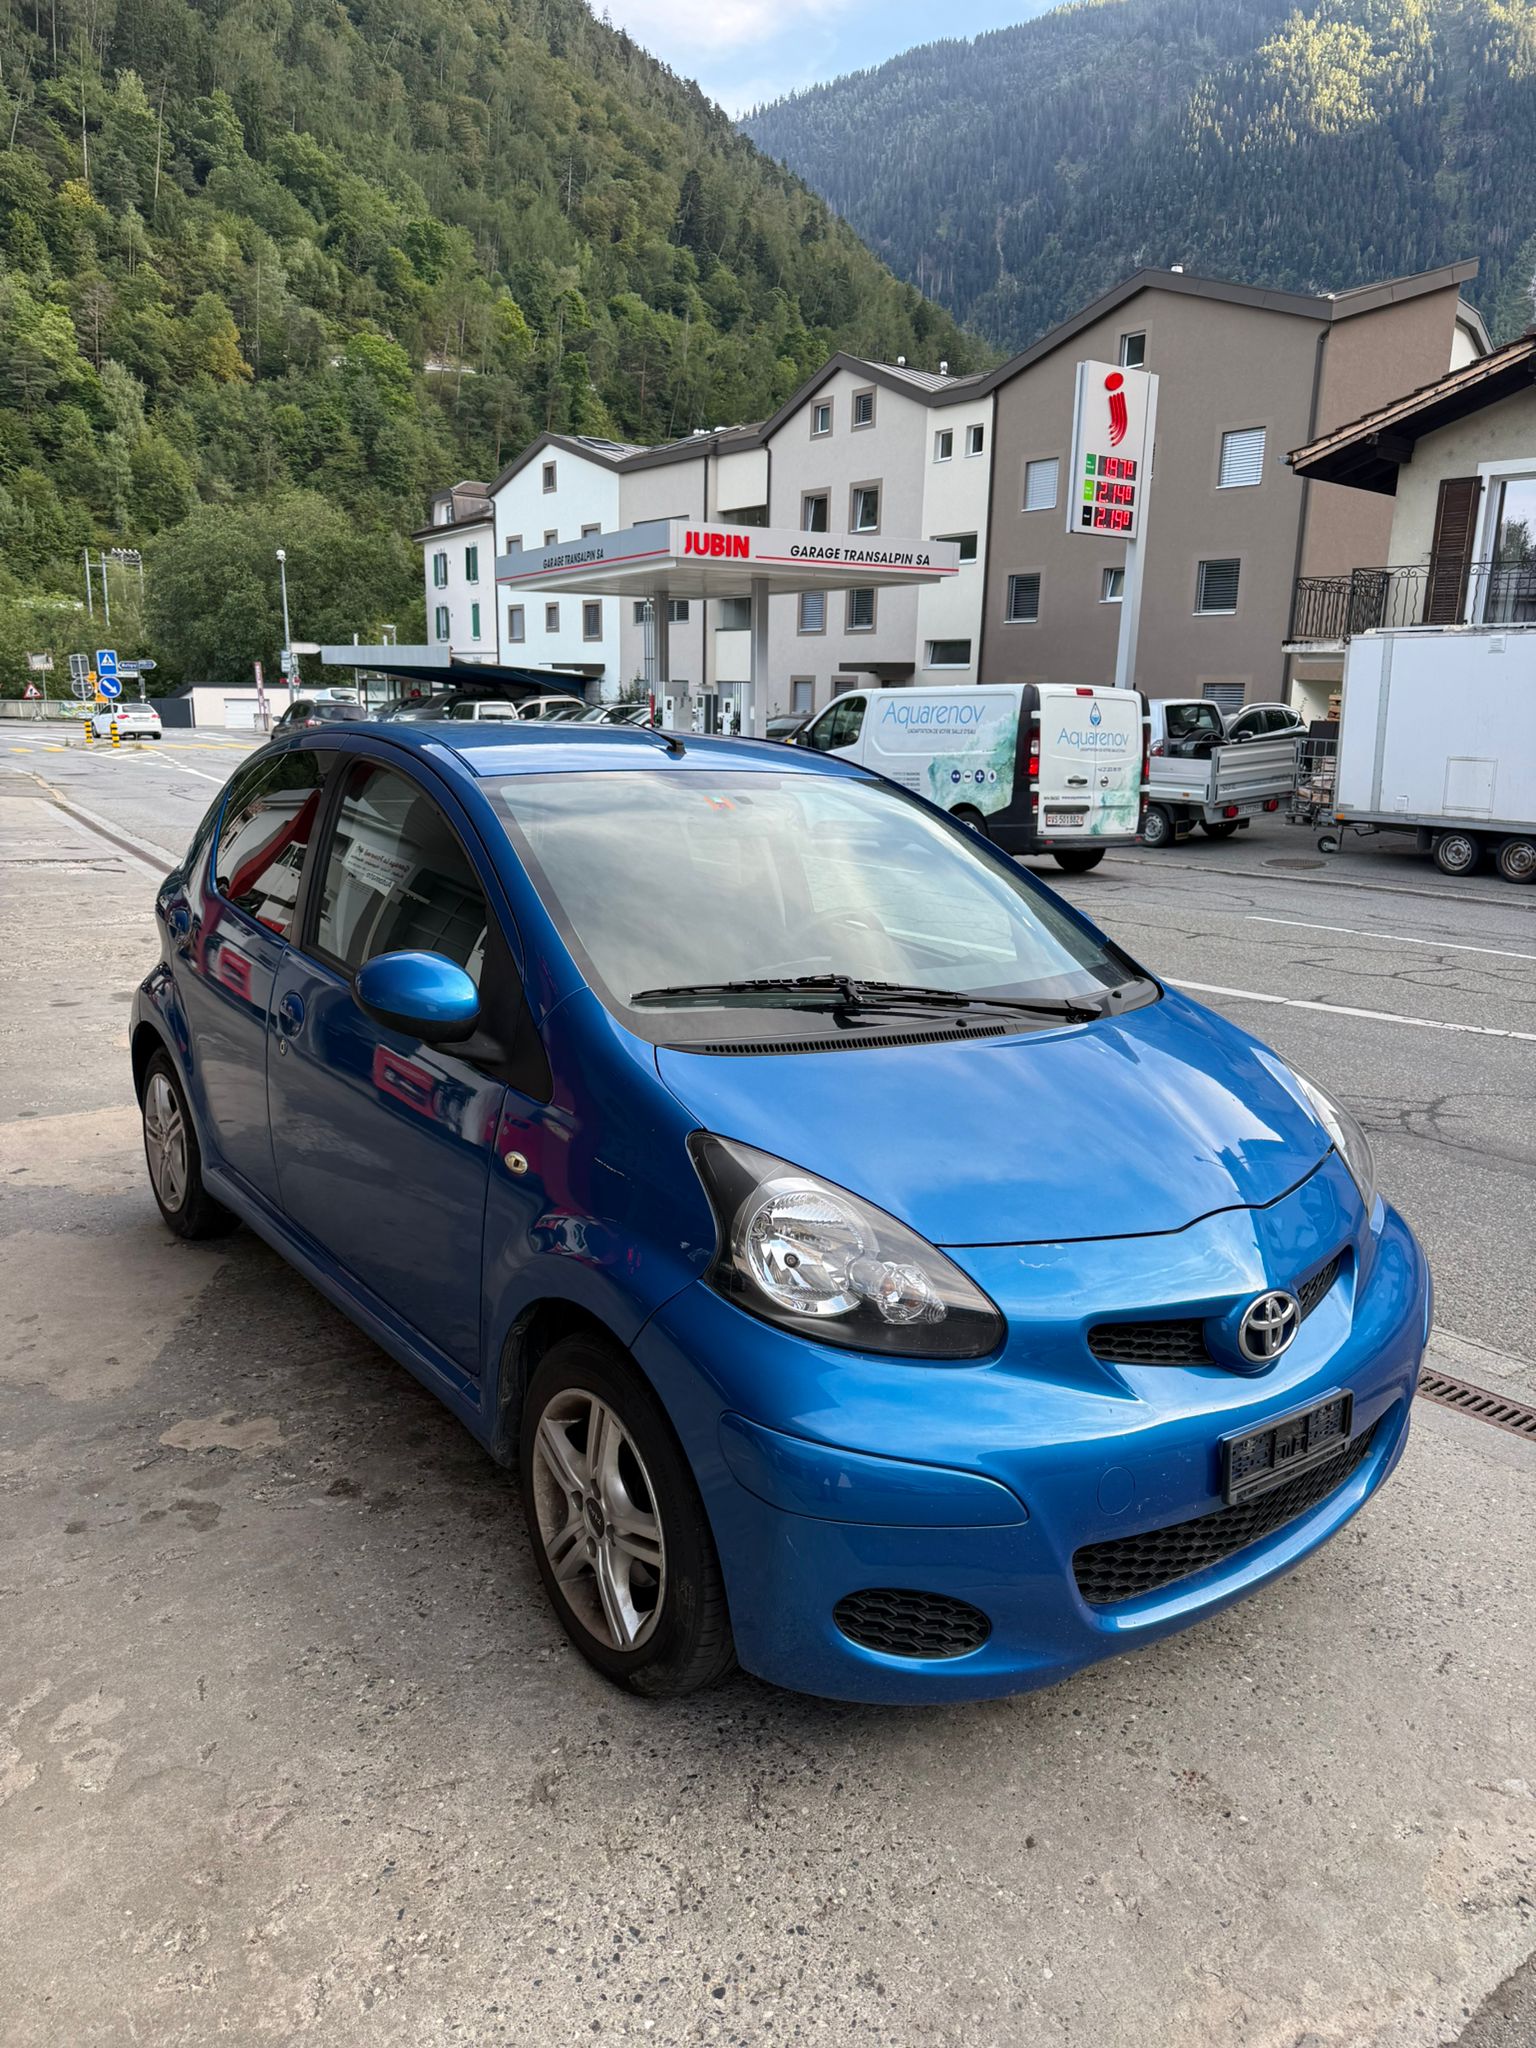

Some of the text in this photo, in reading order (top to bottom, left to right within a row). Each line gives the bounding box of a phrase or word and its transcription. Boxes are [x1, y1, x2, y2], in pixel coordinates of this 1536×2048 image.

[684, 531, 750, 558] JUBIN
[790, 545, 930, 566] GARAGE TRANSALPIN SA
[542, 548, 604, 569] GARAGE TRANSALPIN SA
[882, 700, 986, 729] Aquarenov
[1057, 727, 1129, 749] Aquarenov
